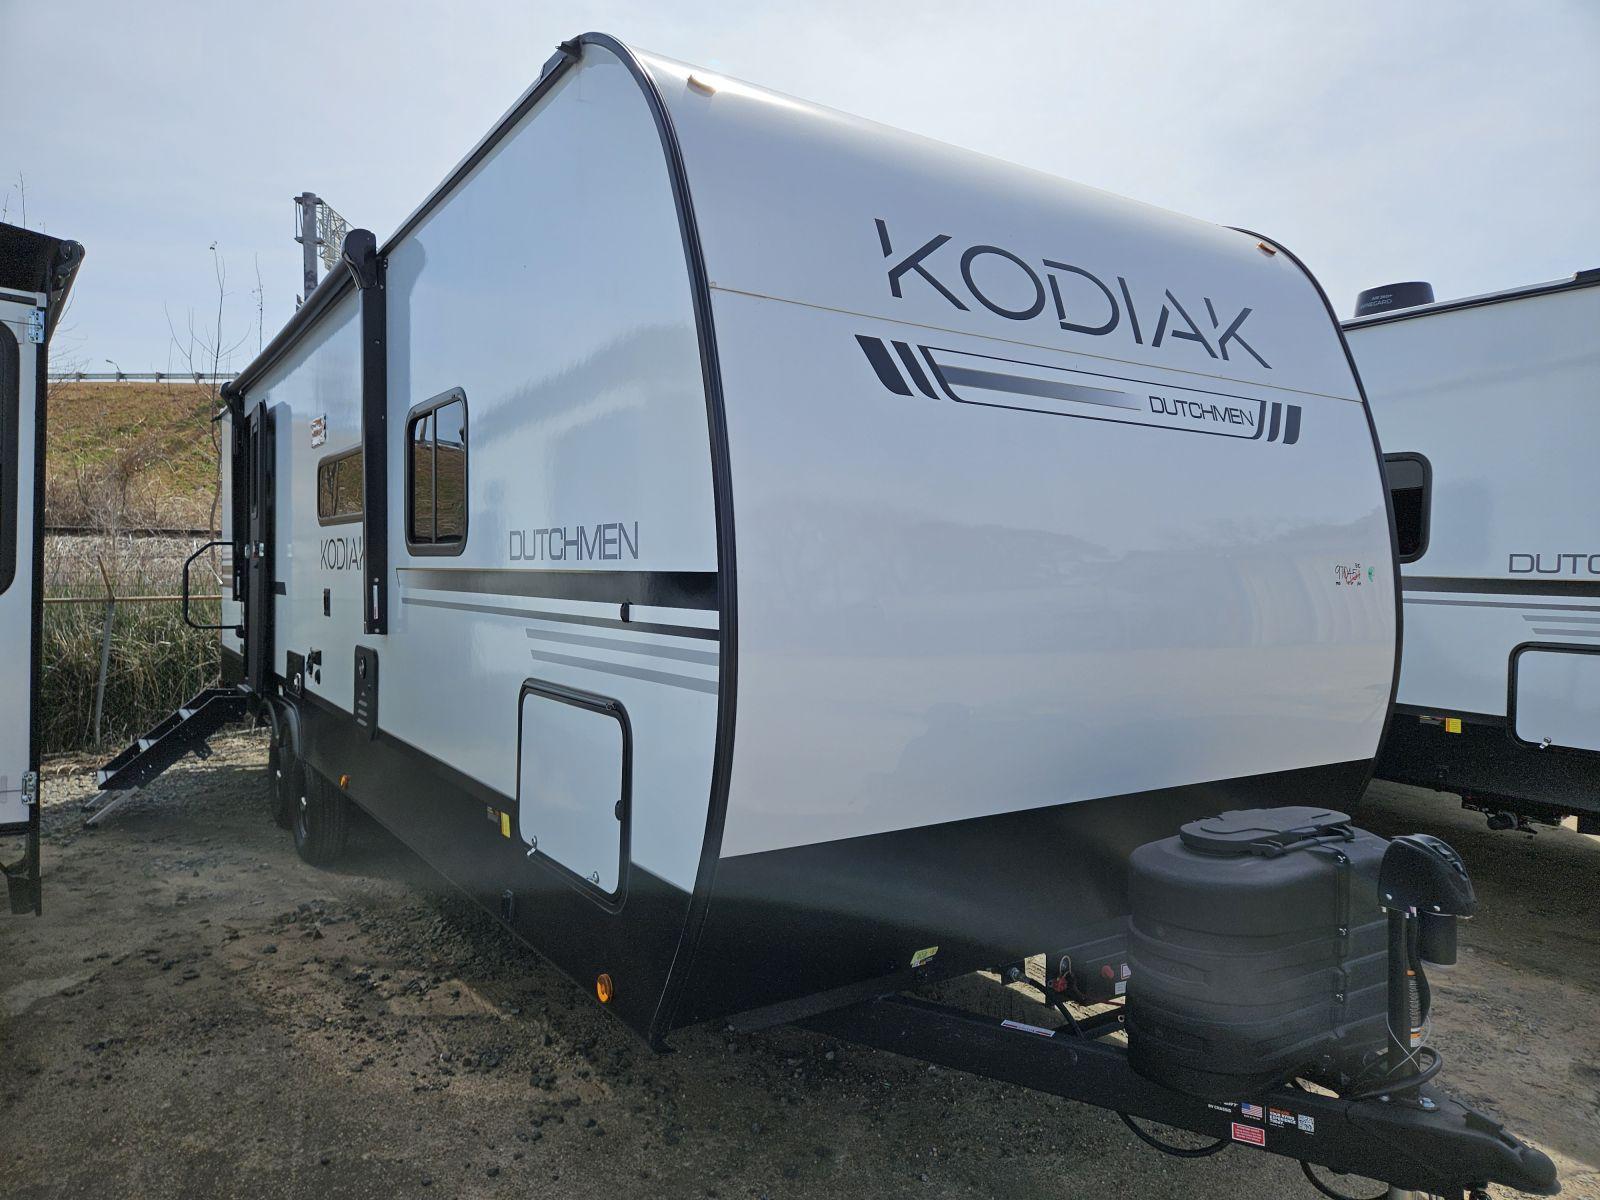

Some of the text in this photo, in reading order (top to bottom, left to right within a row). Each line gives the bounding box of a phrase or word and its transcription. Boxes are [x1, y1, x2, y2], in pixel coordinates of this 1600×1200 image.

[874, 217, 1272, 370] KODIAK
[1149, 395, 1254, 427] DUTCHMEN
[509, 521, 639, 561] DUTCHMEN
